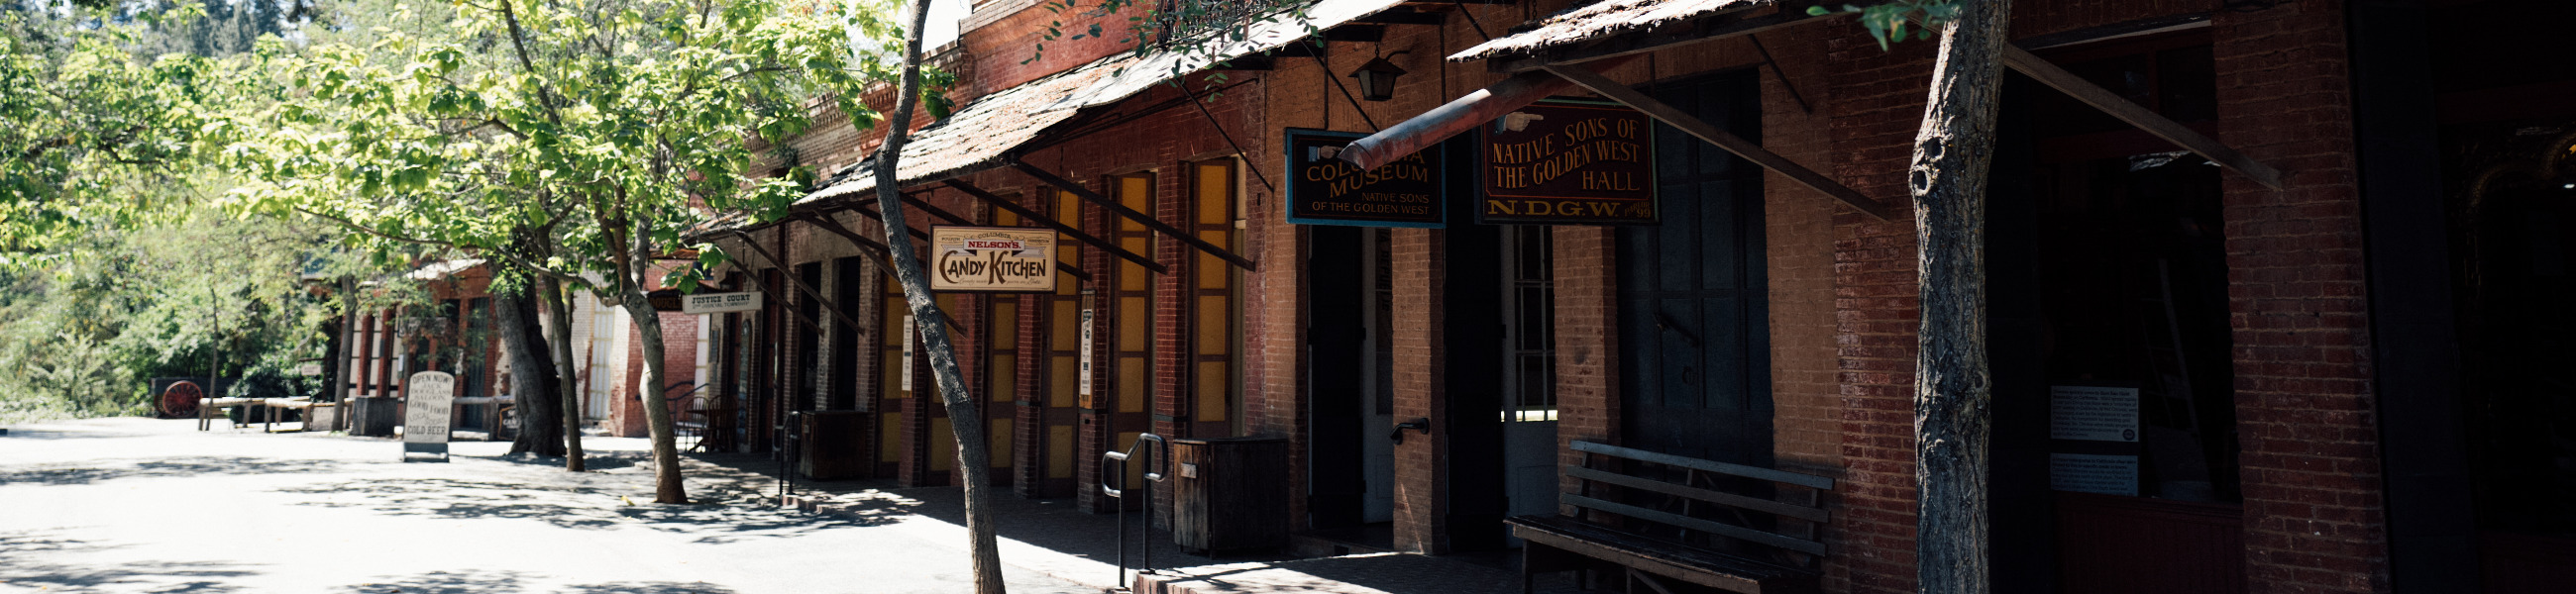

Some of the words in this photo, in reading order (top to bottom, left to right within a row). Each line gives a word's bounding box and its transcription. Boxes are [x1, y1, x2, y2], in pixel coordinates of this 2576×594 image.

[1493, 133, 1556, 164] NATIVE
[1564, 118, 1608, 147] SONS
[1617, 118, 1640, 141] OF
[1493, 165, 1528, 189] THE
[1533, 144, 1590, 185] GOLDEN
[1595, 140, 1640, 163] WEST
[1330, 163, 1429, 198] MUSEUM
[1581, 171, 1640, 191] HALL
[1361, 191, 1398, 202] NATIVE
[1400, 193, 1430, 204] SONS
[1312, 201, 1327, 211] OF
[1330, 202, 1350, 212] THE
[1353, 203, 1398, 214] GOLDEN
[1401, 204, 1430, 215] WEST
[1487, 200, 1621, 217] N.D.G.W.
[1637, 208, 1651, 219] 99
[938, 249, 988, 284] CANDY
[988, 250, 1046, 285] KITCHEN
[692, 295, 721, 304] JUSTICE
[412, 375, 431, 384] OPEN
[407, 426, 426, 435] COLD
[427, 426, 446, 435] BEER
